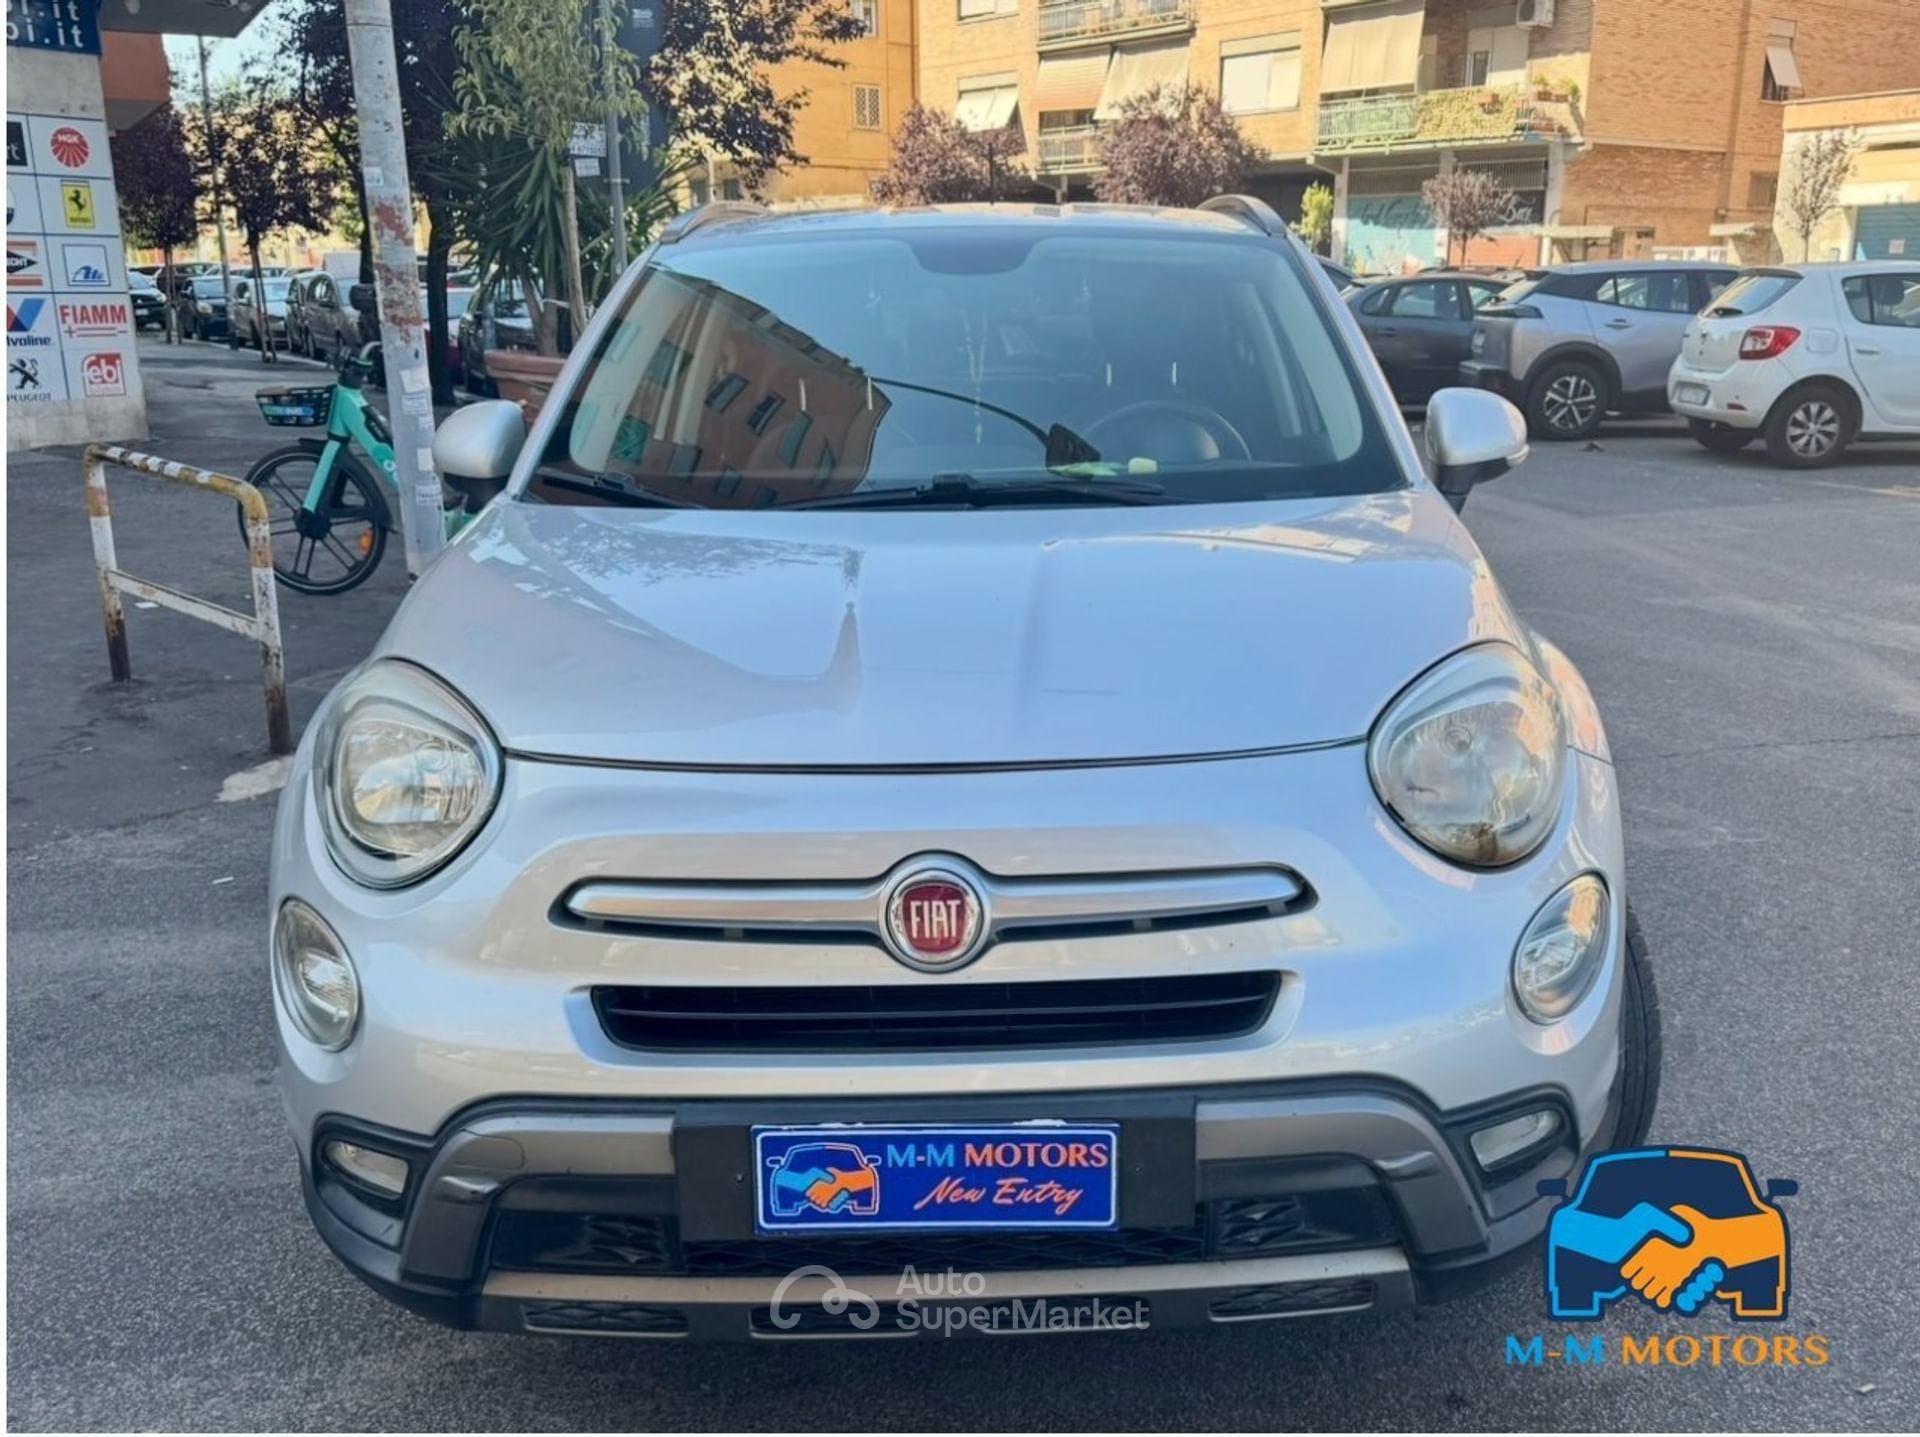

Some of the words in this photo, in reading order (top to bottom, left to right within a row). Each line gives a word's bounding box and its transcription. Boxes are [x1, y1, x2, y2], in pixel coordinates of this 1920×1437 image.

[57, 134, 79, 143] NGK
[60, 304, 127, 324] FIAMM
[910, 899, 961, 939] FIAT
[887, 1143, 954, 1168] M-M
[964, 1143, 1108, 1168] MOTORS
[913, 1176, 986, 1210] New
[992, 1177, 1084, 1216] Entry
